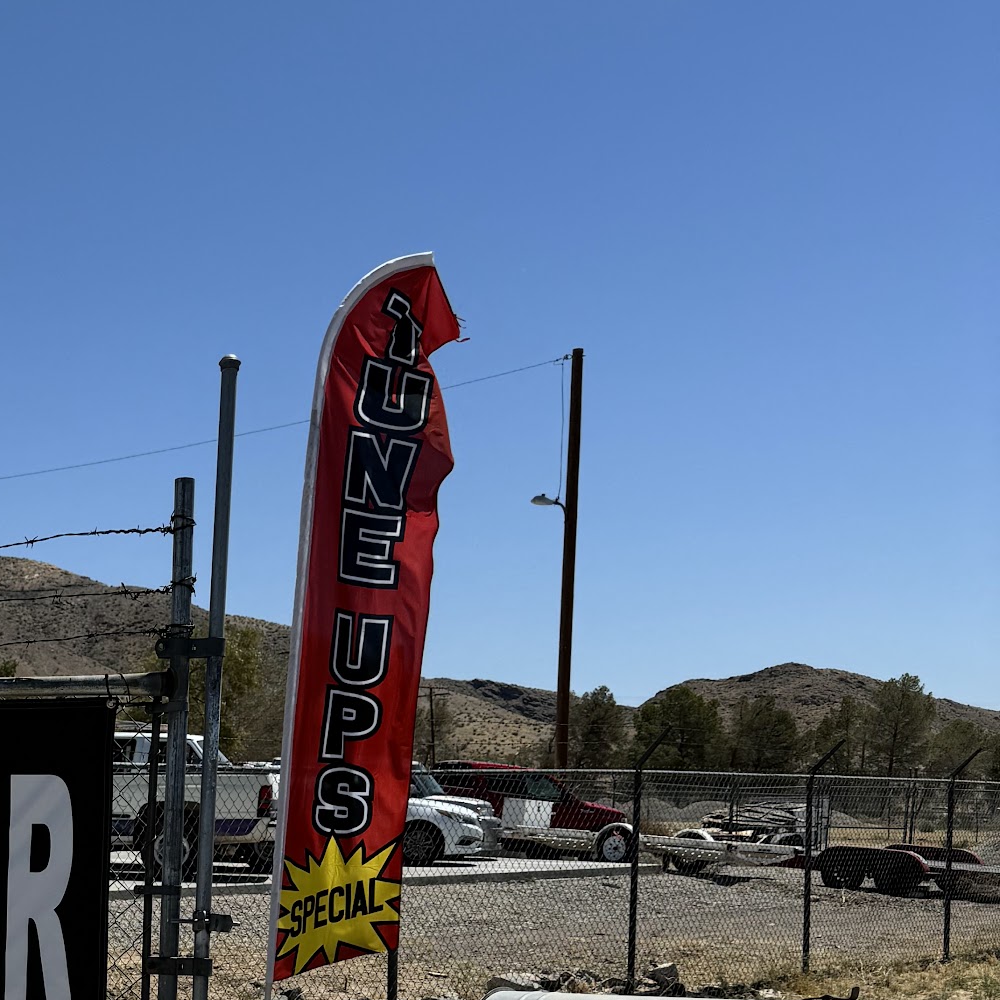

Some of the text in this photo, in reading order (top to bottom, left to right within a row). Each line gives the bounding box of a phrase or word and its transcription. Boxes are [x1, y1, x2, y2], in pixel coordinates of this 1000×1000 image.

[313, 290, 432, 837] TUNE UPS
[289, 877, 384, 938] SPECIAL
